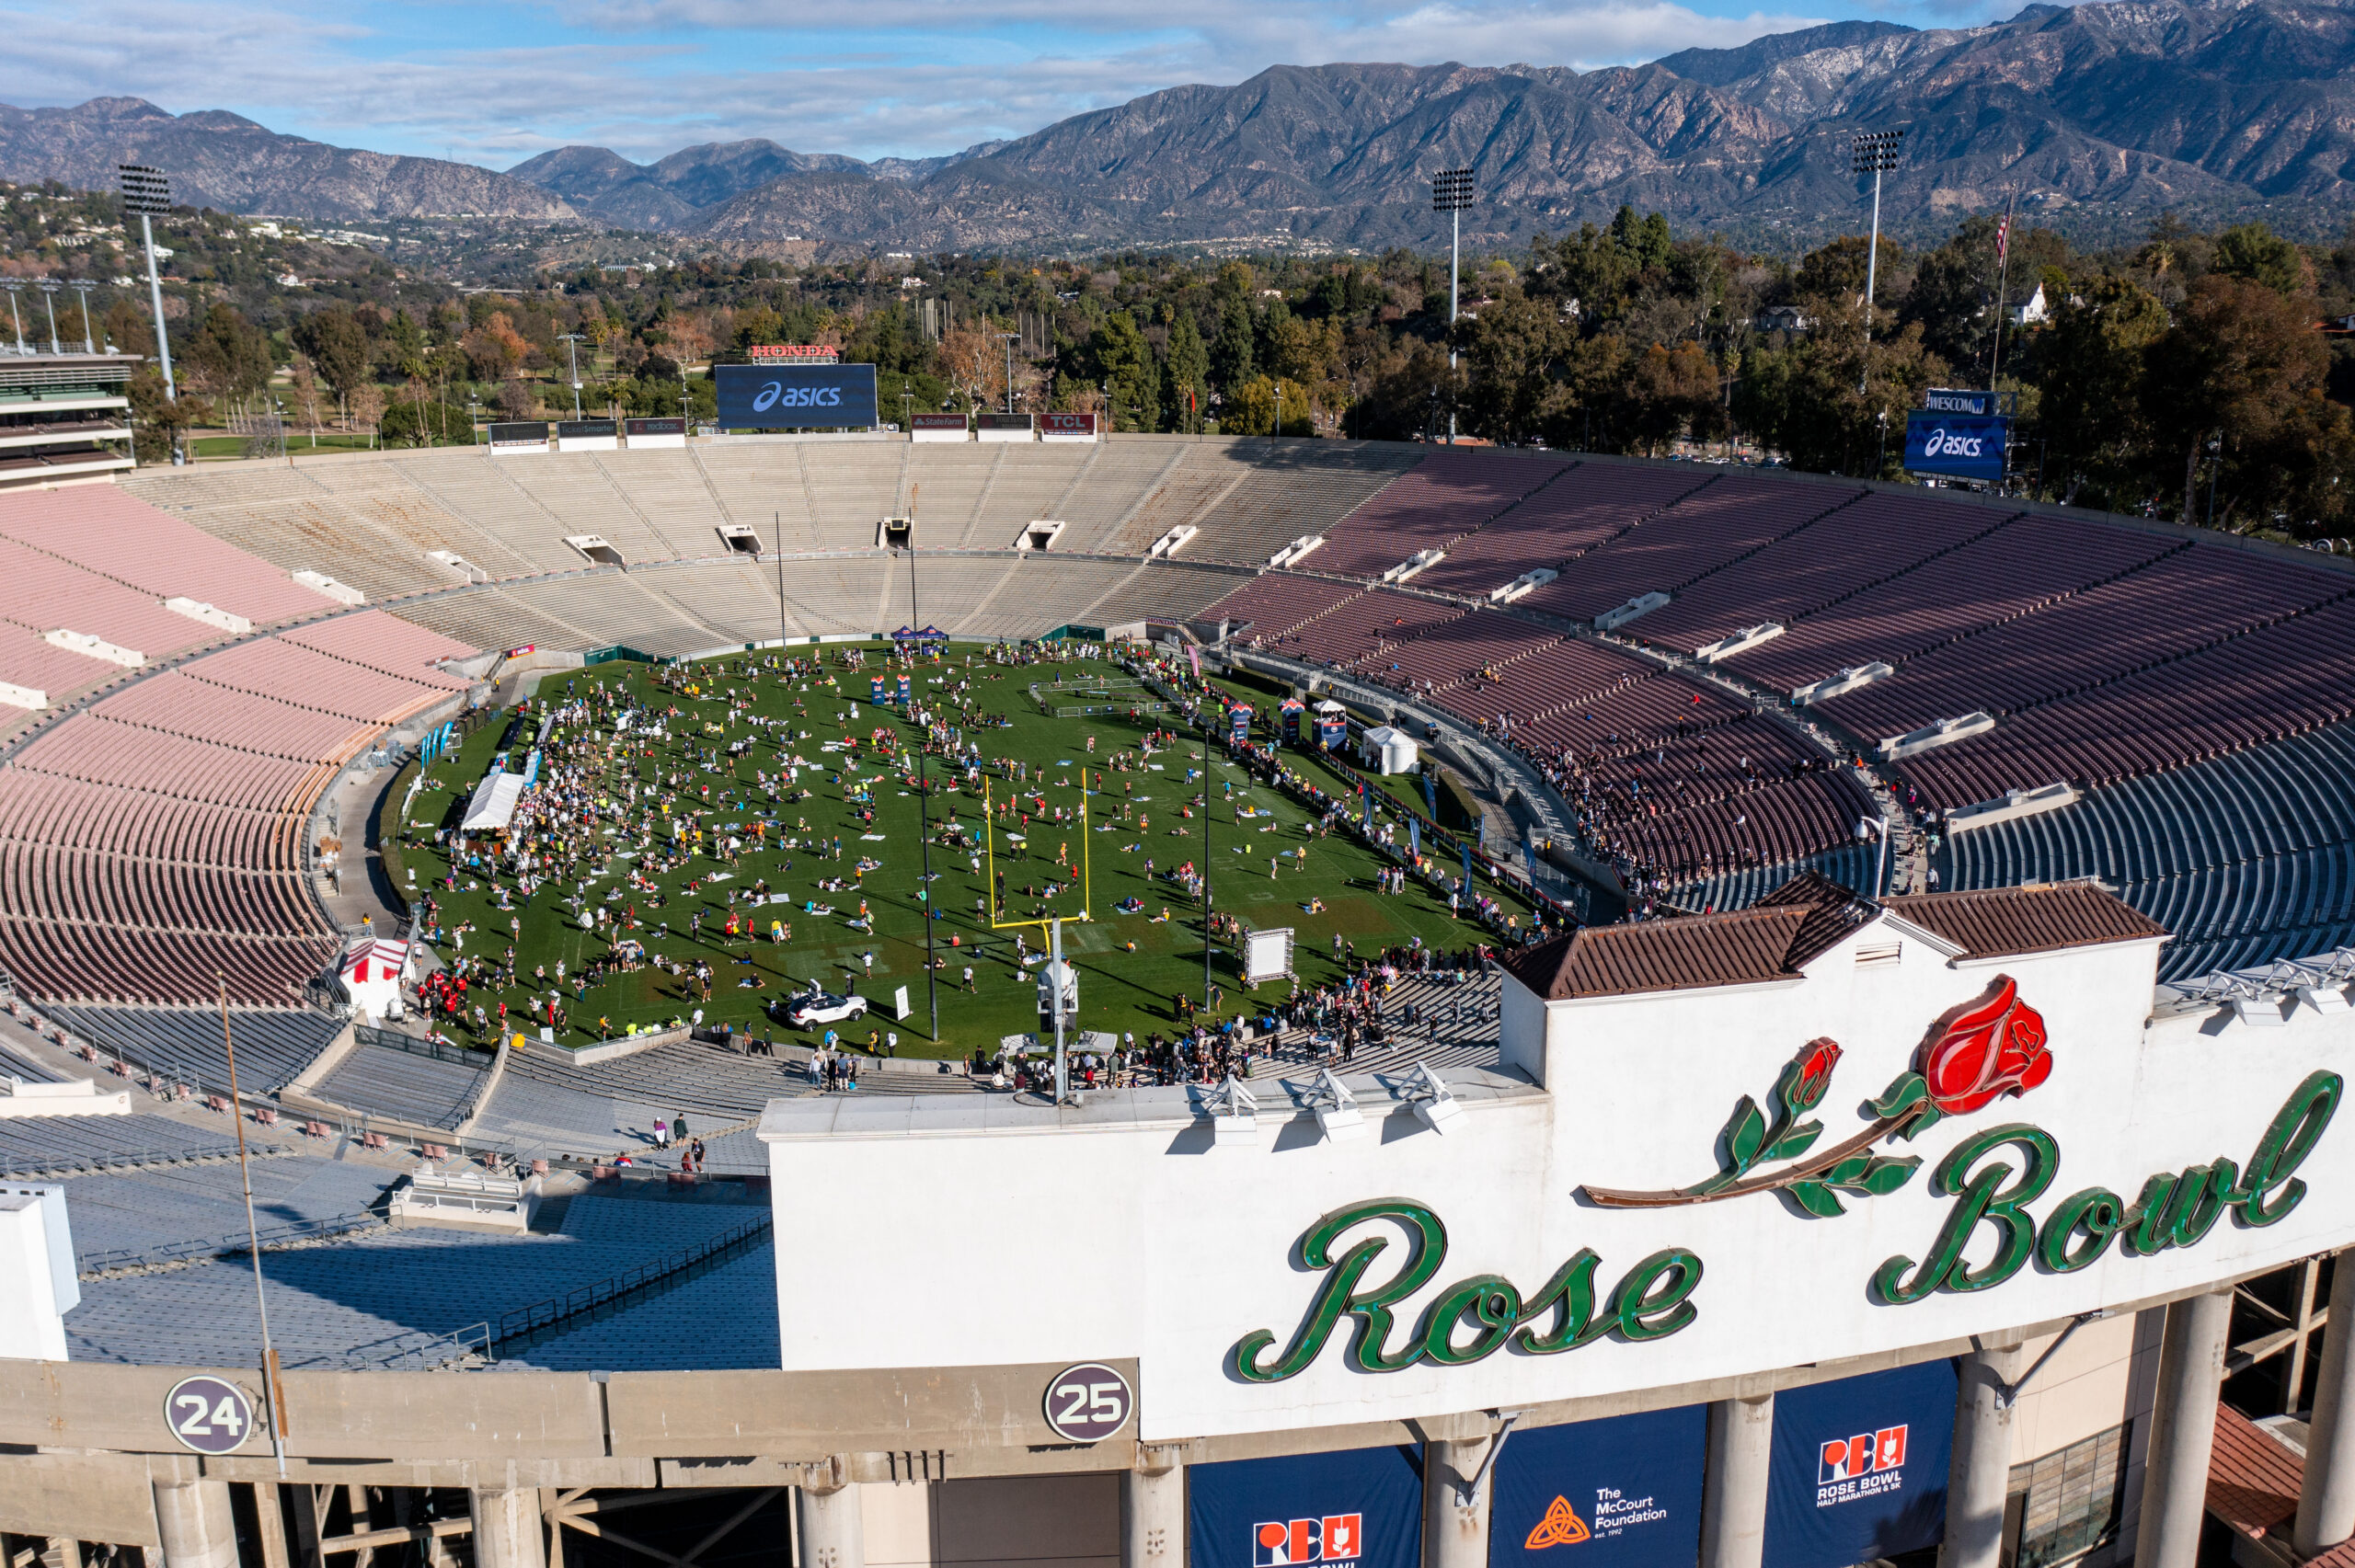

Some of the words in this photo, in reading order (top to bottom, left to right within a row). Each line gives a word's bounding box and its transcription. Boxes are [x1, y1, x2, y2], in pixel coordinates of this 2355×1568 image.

[751, 345, 839, 357] HONDA
[782, 387, 841, 406] asics
[1929, 396, 1972, 413] WESCOM
[561, 424, 615, 433] TicketSmarter
[1050, 416, 1086, 428] TCL
[1942, 436, 1982, 457] asics
[1147, 617, 1177, 626] HONDA
[1235, 1196, 1704, 1382] Rose
[1877, 1069, 2344, 1305] Bowl
[1056, 1381, 1122, 1425] 25
[176, 1394, 243, 1436] 24
[1596, 1487, 1622, 1501] The
[1817, 1481, 1855, 1500] ROSE
[1860, 1470, 1902, 1490] BOWL
[1816, 1496, 1837, 1508] HALF
[1838, 1486, 1881, 1504] MARATHON
[1883, 1484, 1890, 1493] &
[1890, 1482, 1901, 1491] 5K
[1595, 1496, 1653, 1516] McCourt
[1594, 1509, 1667, 1529] Foundation
[1594, 1531, 1606, 1539] est.
[1608, 1528, 1623, 1537] 1992
